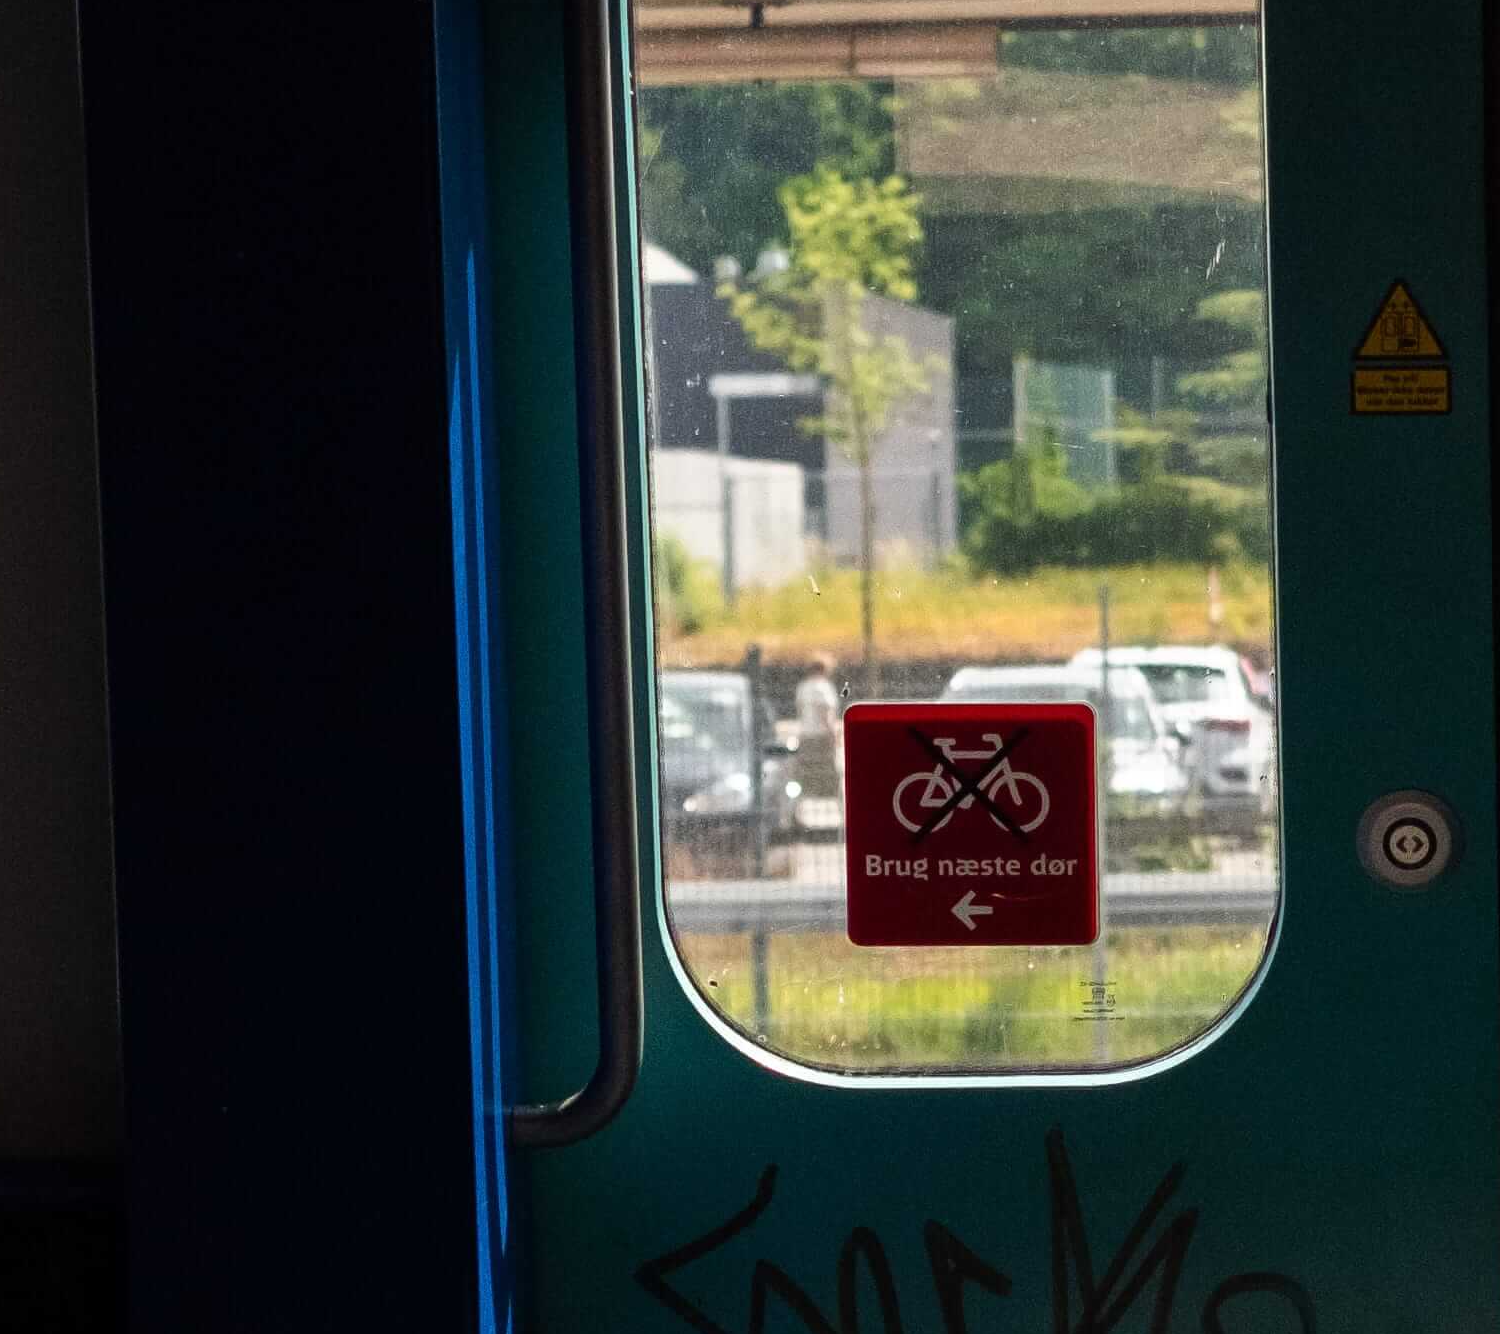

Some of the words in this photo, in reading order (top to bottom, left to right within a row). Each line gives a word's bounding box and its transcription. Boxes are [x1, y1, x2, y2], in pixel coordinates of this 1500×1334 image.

[865, 853, 929, 881] Brug
[938, 856, 1021, 877] næste
[1029, 852, 1079, 876] dør
